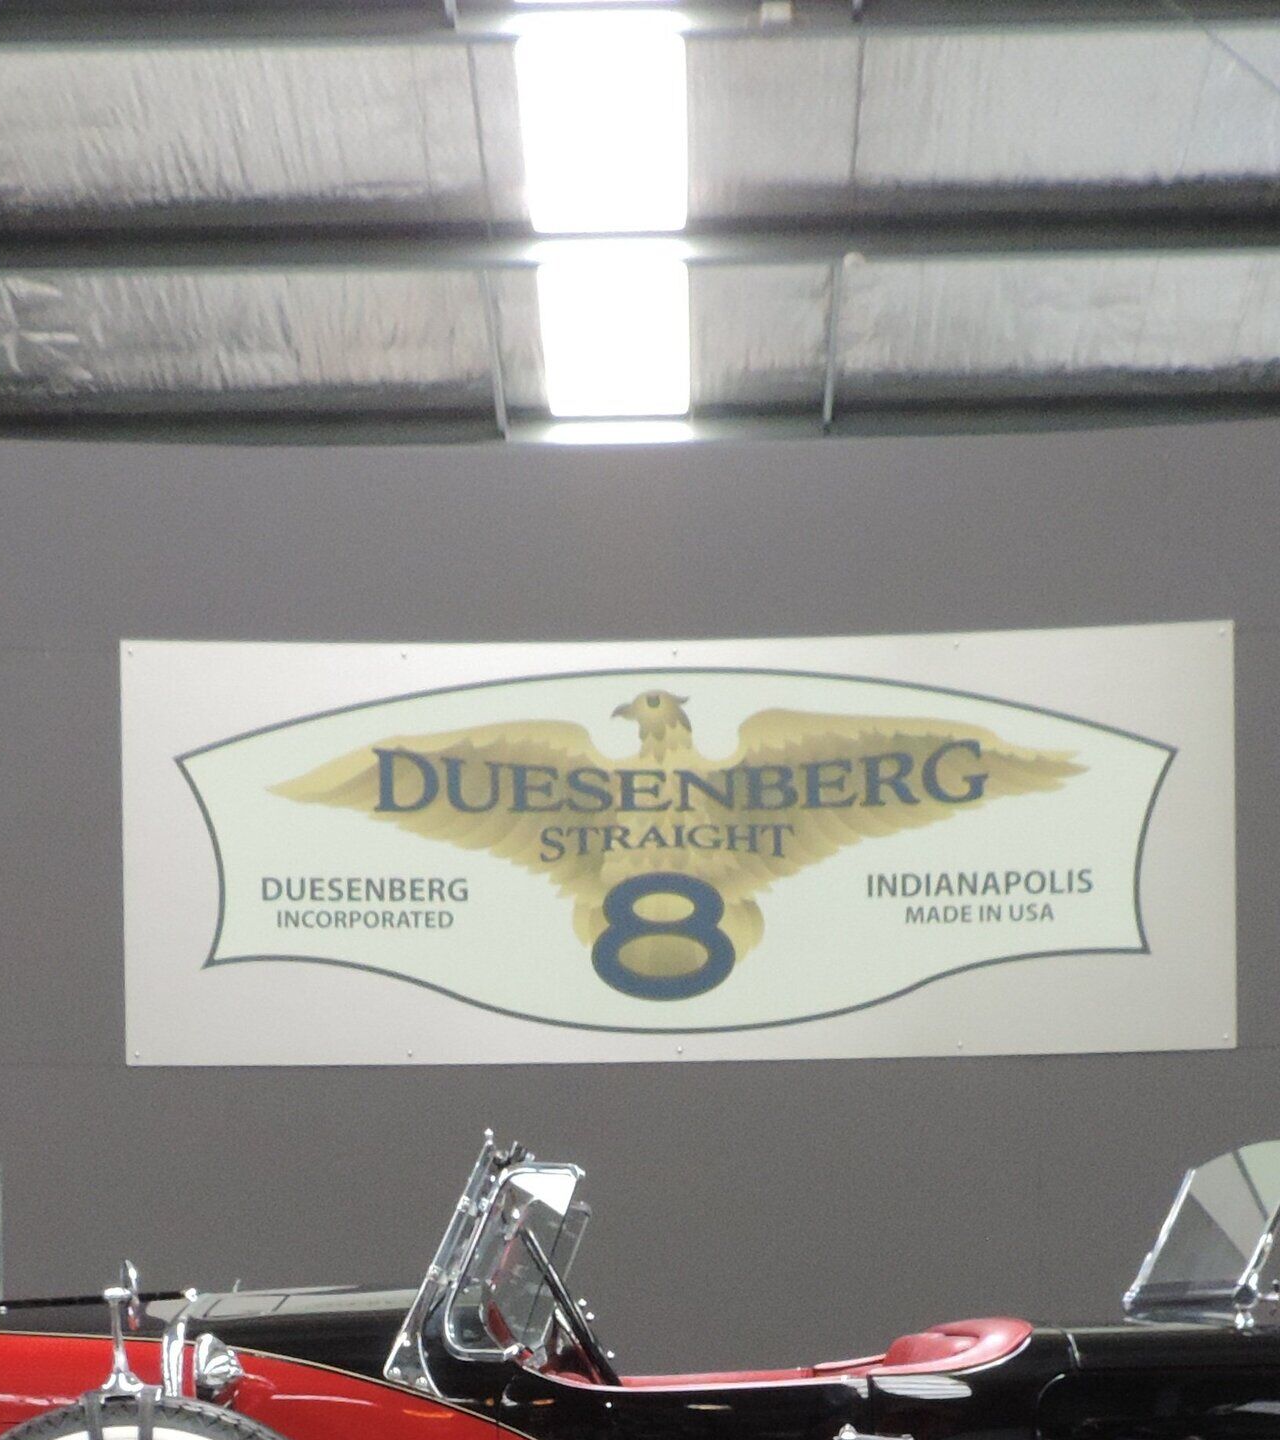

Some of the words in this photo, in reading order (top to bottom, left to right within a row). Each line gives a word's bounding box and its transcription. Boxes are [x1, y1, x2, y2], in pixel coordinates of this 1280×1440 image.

[374, 740, 989, 813] DUESENBERG
[540, 822, 795, 863] STRAIGHT
[261, 876, 469, 902] DUESENBERG
[867, 868, 1094, 898] INDIANAPOLIS
[277, 910, 455, 929] INCORPORATED
[905, 904, 973, 924] MADE
[979, 904, 1002, 922] IN
[1009, 903, 1055, 922] USA
[591, 872, 736, 1002] 8
